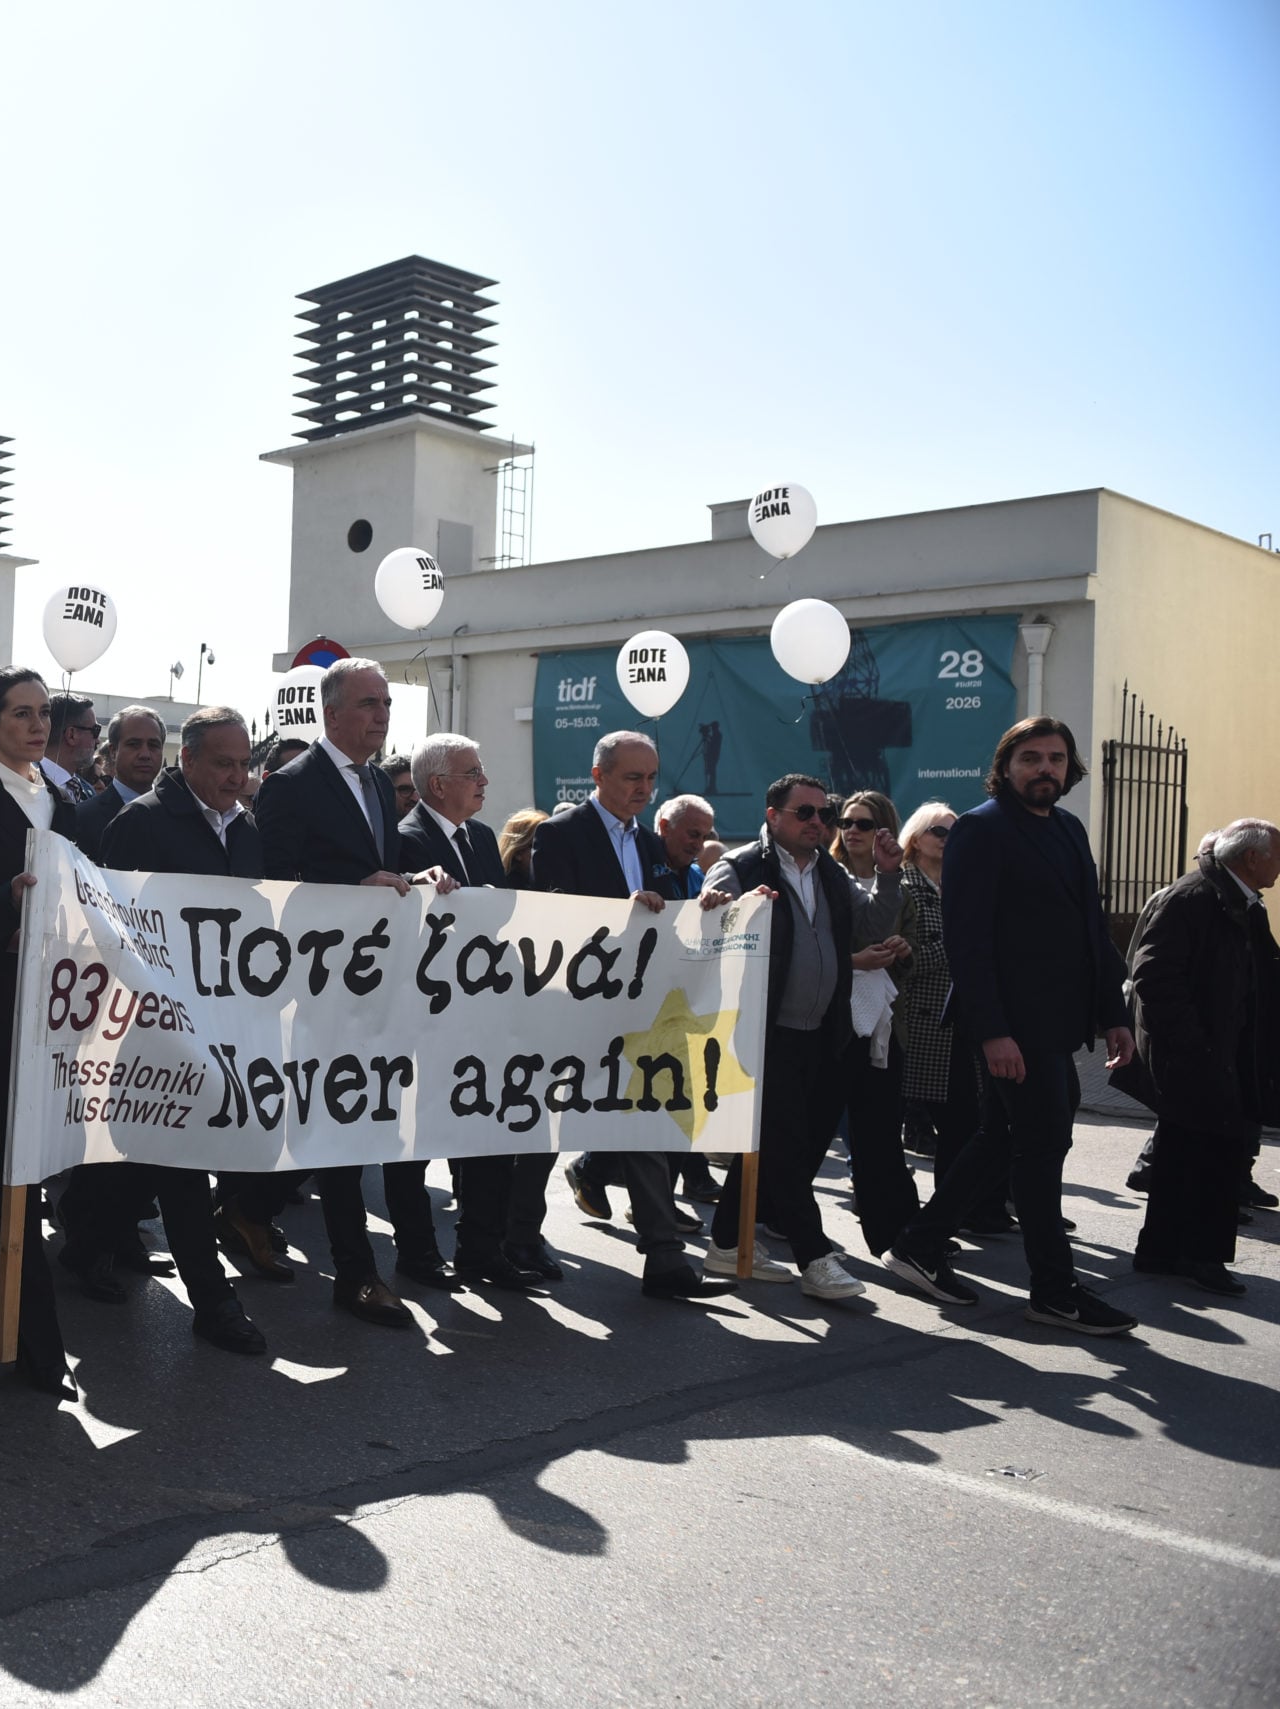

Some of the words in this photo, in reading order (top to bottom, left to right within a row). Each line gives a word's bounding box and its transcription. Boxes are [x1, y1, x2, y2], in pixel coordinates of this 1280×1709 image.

[754, 502, 791, 523] ΞΑΝΑ
[67, 586, 107, 608] ΠΟΤΕ
[62, 603, 104, 628] ΞΑΝΑ
[629, 648, 667, 664] ΠΟΤΕ
[938, 650, 984, 678] 28
[628, 667, 667, 683] ΞΑΝΑ
[277, 686, 316, 705] ΠΟΤΕ
[558, 676, 597, 702] tidf
[946, 696, 981, 709] 2026
[277, 707, 317, 726] ΞΑΝΑ
[918, 767, 981, 778] international
[180, 907, 390, 997] Ποτέ
[48, 958, 109, 1032] 83
[102, 986, 195, 1041] years
[52, 1053, 206, 1096] Thessaloniki
[208, 1043, 414, 1131] Never
[450, 1035, 721, 1133] again!
[64, 1091, 192, 1129] Auschwitz
